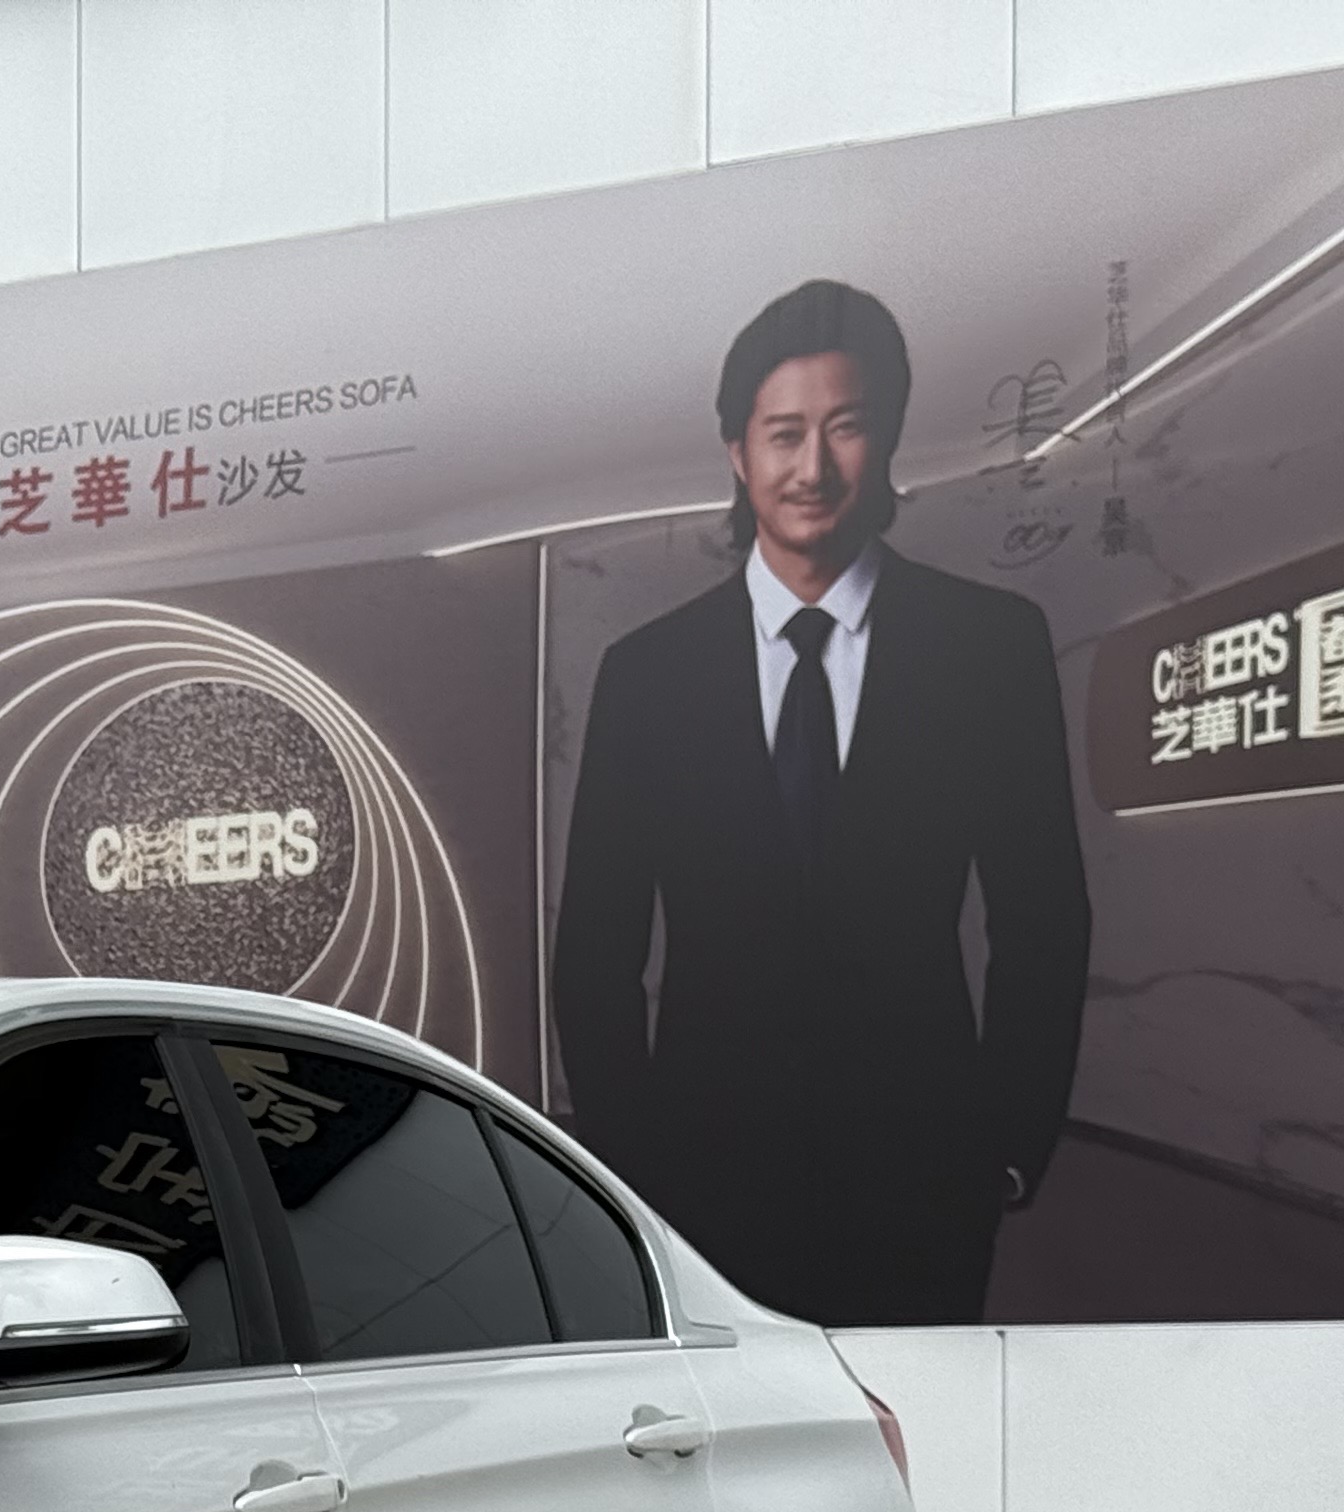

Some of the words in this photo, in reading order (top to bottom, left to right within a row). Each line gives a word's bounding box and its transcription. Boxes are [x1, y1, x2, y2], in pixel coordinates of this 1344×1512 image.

[0, 421, 89, 458] GREAT
[94, 408, 180, 444] VALUE
[187, 405, 212, 432] IS
[218, 386, 333, 428] CHEERS
[339, 375, 418, 410] SOFA
[1152, 612, 1290, 703] CHEERS
[1151, 685, 1290, 765] 芝華仕
[85, 808, 319, 893] CHEERS
